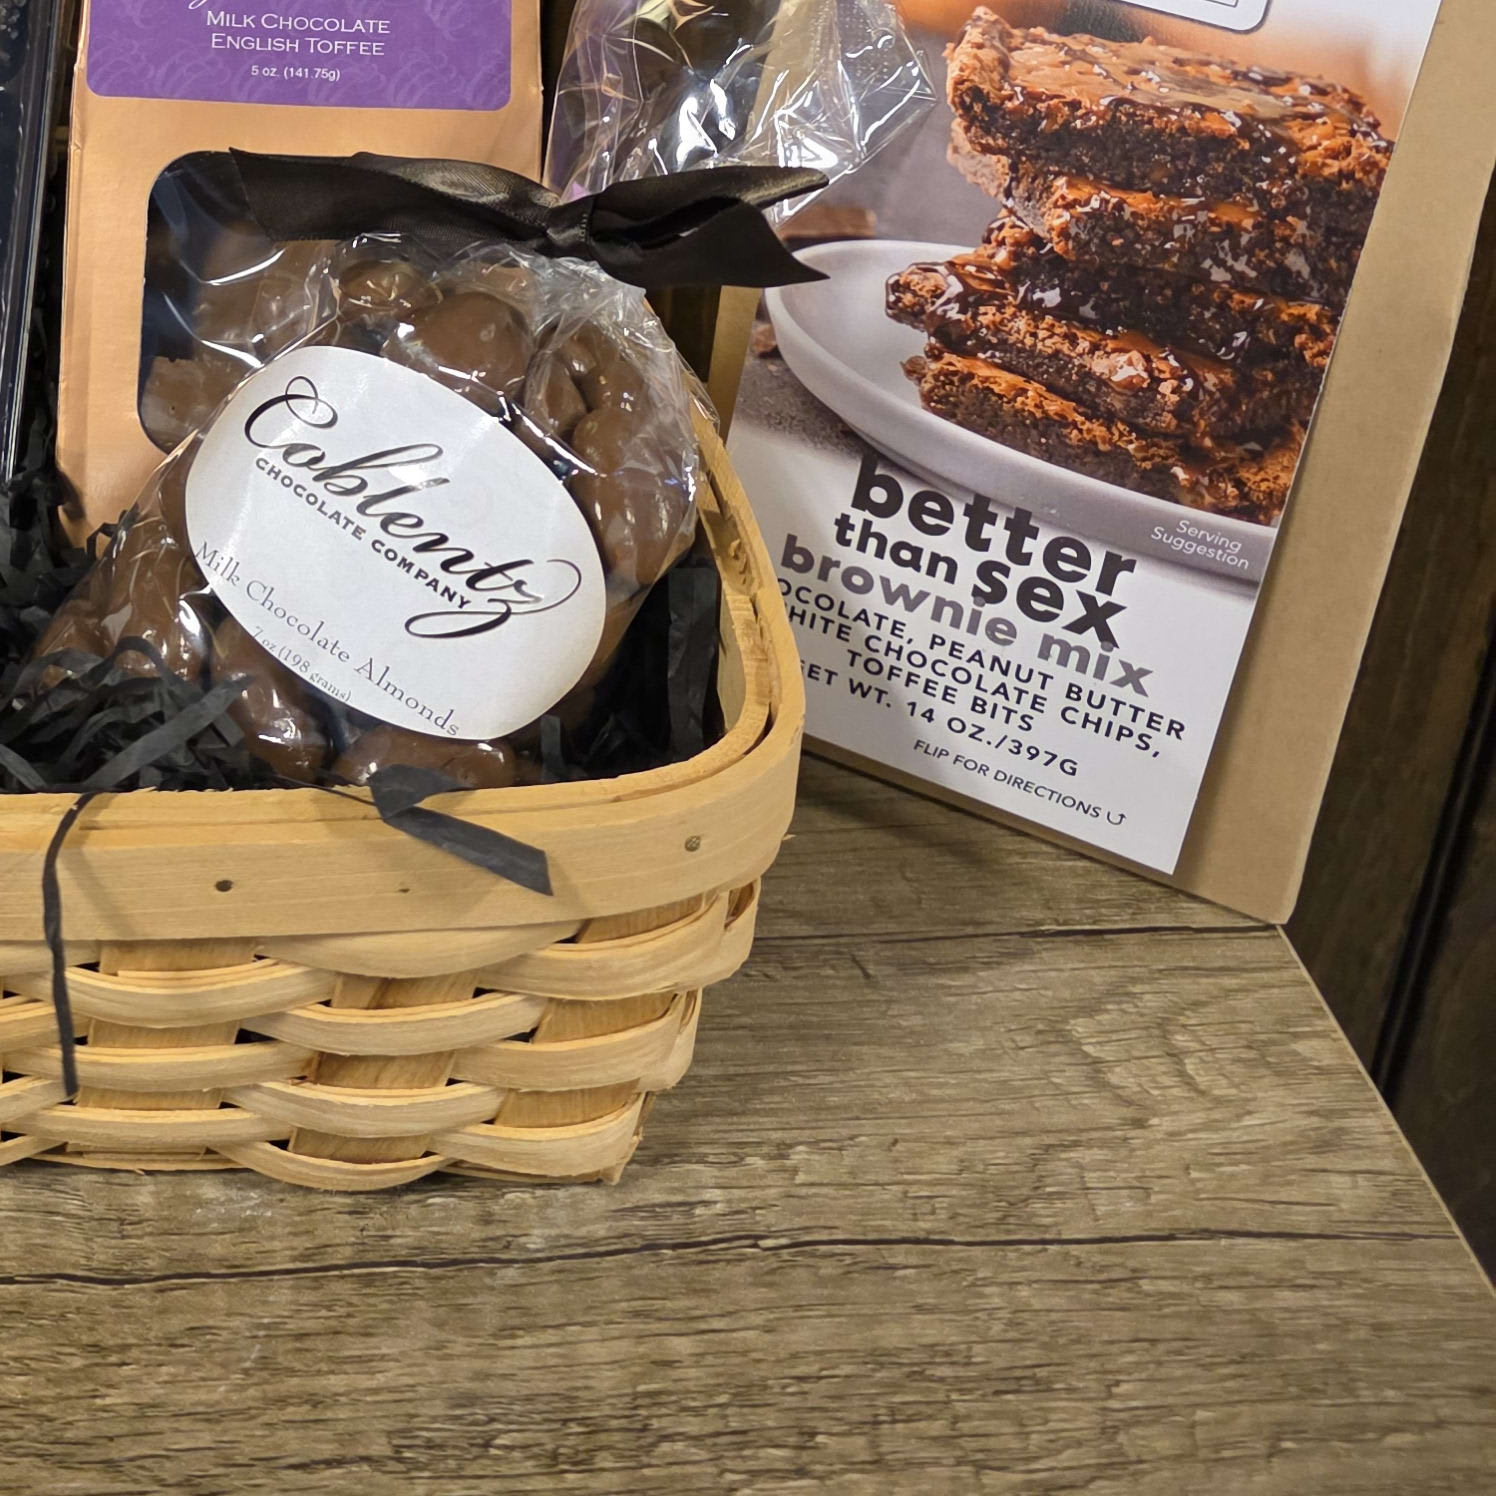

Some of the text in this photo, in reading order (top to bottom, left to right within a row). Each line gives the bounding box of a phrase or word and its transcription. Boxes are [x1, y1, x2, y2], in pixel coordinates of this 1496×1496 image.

[251, 65, 259, 76] 5
[283, 66, 341, 81] (141.75g)
[244, 376, 582, 638] Coblentz
[255, 457, 472, 609] CHOCOLATE COMPANY
[850, 453, 1138, 597] better
[1151, 526, 1249, 569] Suggestion
[1176, 520, 1242, 554] Serving
[194, 542, 460, 736] Milk Chocolate Almonds
[781, 534, 1154, 697] brownie mix
[834, 512, 1128, 649] than sex
[253, 625, 261, 641] 7
[278, 645, 310, 672] (198
[309, 672, 352, 702] grams)
[786, 602, 1163, 759] HITE CHOCOLATE CHIPS,
[801, 660, 1078, 777] ET WT. 14 OZ./397G
[847, 649, 1036, 733] TOFFEE BITS
[929, 632, 1054, 691] PEANUT
[1065, 681, 1186, 740] BUTTER
[913, 739, 1102, 819] FLIP FOR DIRECTIONS
